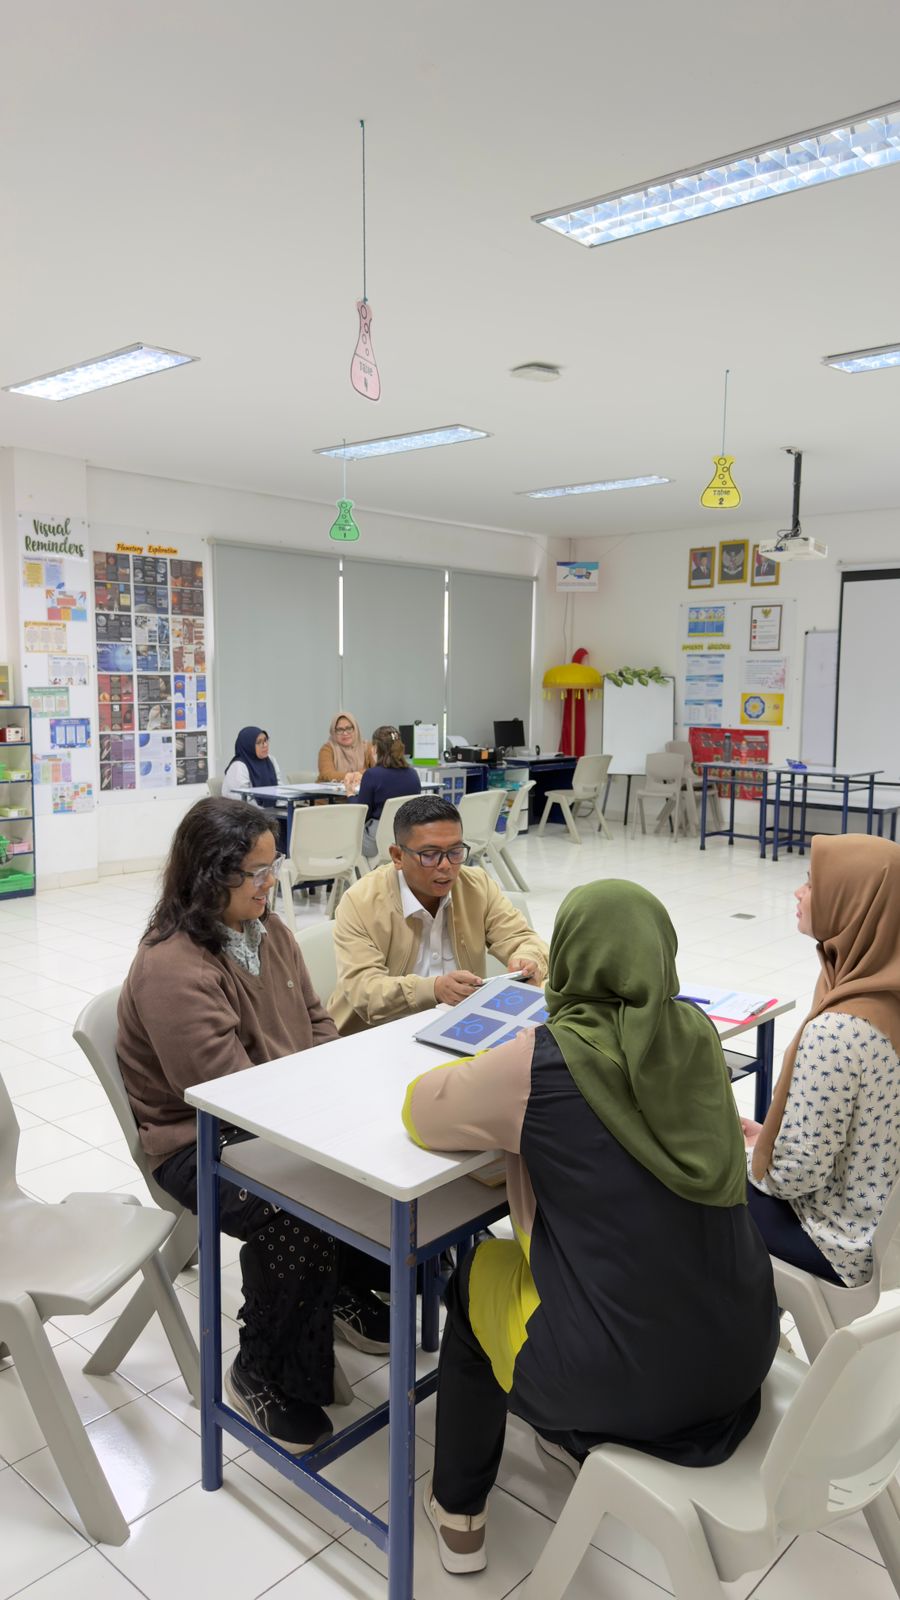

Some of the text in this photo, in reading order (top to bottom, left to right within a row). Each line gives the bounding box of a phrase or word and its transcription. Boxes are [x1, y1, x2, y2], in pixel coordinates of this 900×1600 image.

[718, 497, 725, 505] 2
[33, 517, 71, 537] Visual
[25, 535, 85, 557] Reminders
